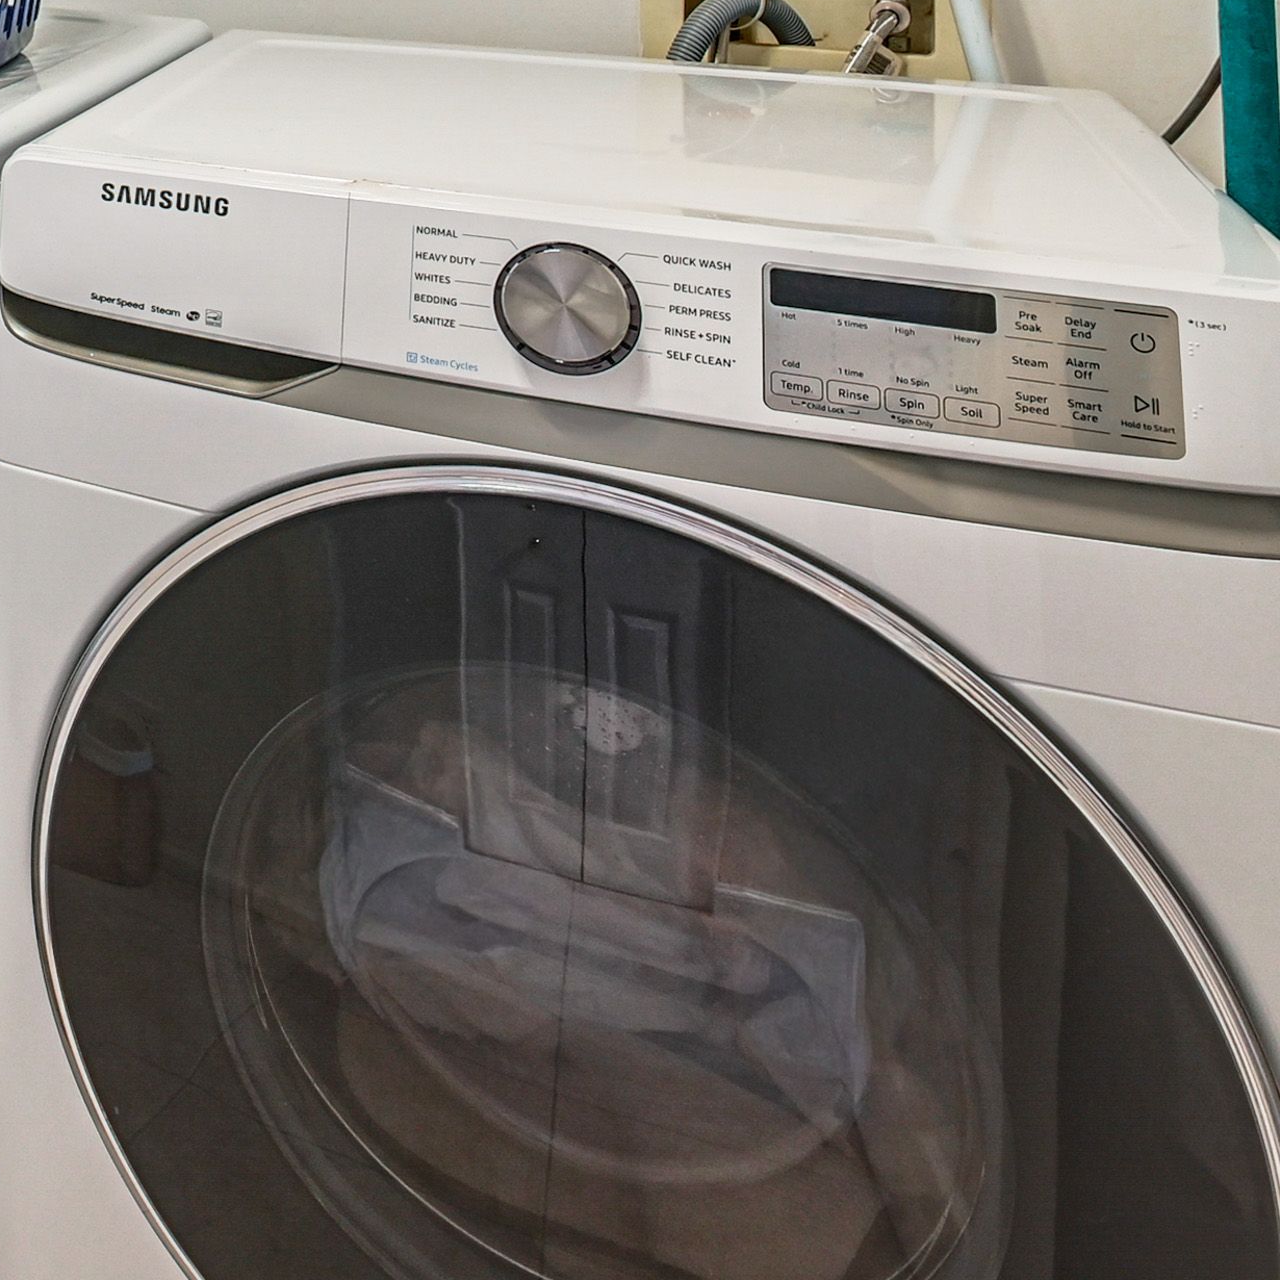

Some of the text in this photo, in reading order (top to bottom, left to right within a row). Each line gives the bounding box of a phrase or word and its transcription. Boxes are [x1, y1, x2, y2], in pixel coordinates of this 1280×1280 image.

[101, 182, 230, 217] SAMSUNG
[416, 225, 458, 238] NORMAL
[415, 251, 476, 266] HEAVY DUTY
[663, 254, 732, 272] QUICK WASH
[414, 272, 452, 285] WHITES
[673, 282, 732, 299] DELICATES
[414, 293, 458, 307] BEDDING
[151, 305, 181, 317] Steam
[669, 304, 732, 322] PERM PRESS
[781, 311, 796, 320] Hot
[1019, 310, 1038, 321] Pre
[413, 314, 456, 328] SANITIZE
[844, 320, 869, 330] times
[1015, 321, 1042, 333] Soak
[1064, 316, 1097, 330] Delay
[664, 326, 697, 340] RINSE
[705, 332, 732, 345] SPIN
[894, 326, 916, 337] High
[1070, 328, 1092, 340] End
[953, 335, 981, 346] Heavy
[666, 349, 693, 362] SELF
[1011, 355, 1049, 369] Steam
[419, 354, 479, 372] Steam Cycles
[781, 359, 801, 369] Cold
[1065, 357, 1101, 370] Alarm
[844, 368, 864, 378] time
[1074, 369, 1093, 380] Off
[780, 379, 814, 395] Temp.
[896, 376, 930, 388] No Spin
[838, 388, 870, 402] Rinse
[955, 384, 979, 395] Light
[899, 397, 925, 410] Spin
[1015, 391, 1048, 404] Super
[827, 405, 845, 414] Lock
[1014, 402, 1050, 416] Speed
[1066, 398, 1103, 413] Smart
[960, 406, 983, 419] Soil
[1072, 410, 1099, 423] Care
[896, 415, 934, 429] Spin Only
[1120, 420, 1176, 435] Hold to Start
